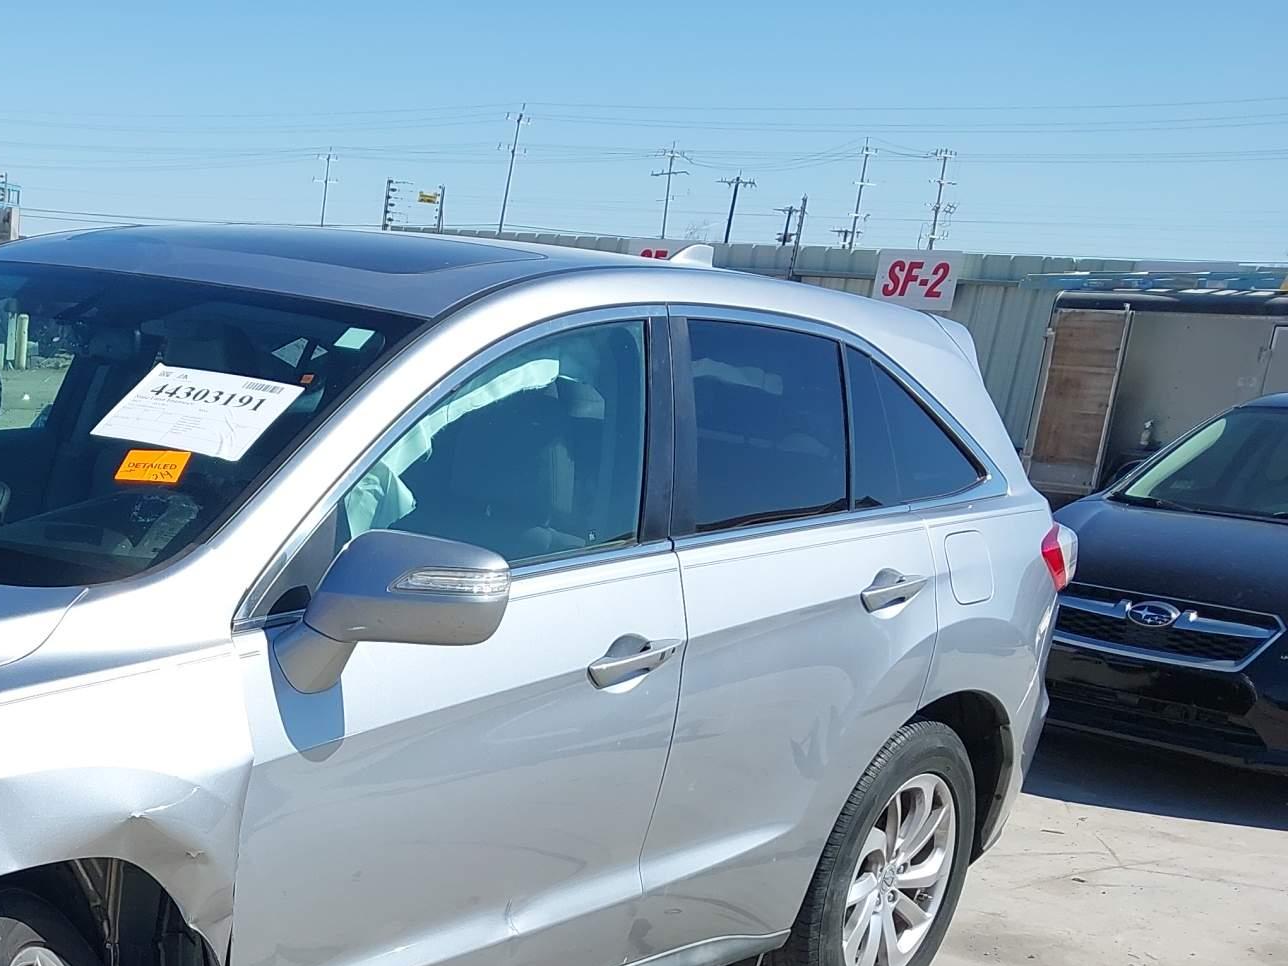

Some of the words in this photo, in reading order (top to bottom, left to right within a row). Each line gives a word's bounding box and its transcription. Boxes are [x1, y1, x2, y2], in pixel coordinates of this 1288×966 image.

[882, 260, 950, 298] SF-2
[150, 383, 267, 411] 44303191
[127, 462, 178, 470] DETAILED
